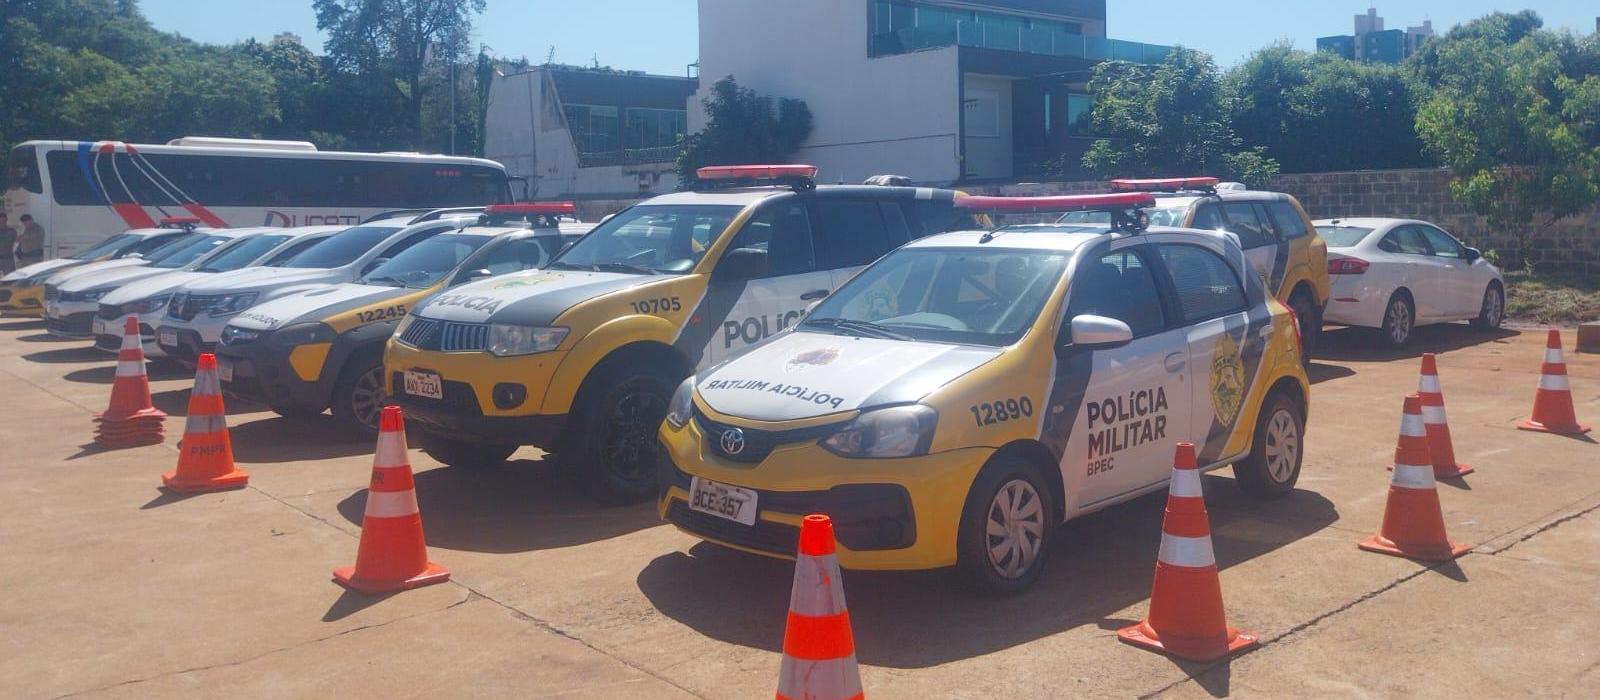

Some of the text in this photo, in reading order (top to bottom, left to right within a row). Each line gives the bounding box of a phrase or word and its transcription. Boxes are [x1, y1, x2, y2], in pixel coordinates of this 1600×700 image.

[356, 304, 407, 323] 12245
[630, 297, 681, 315] 10705
[970, 395, 1033, 427] 12890
[1087, 415, 1167, 460] MILITAR
[1087, 456, 1115, 476] BPEC
